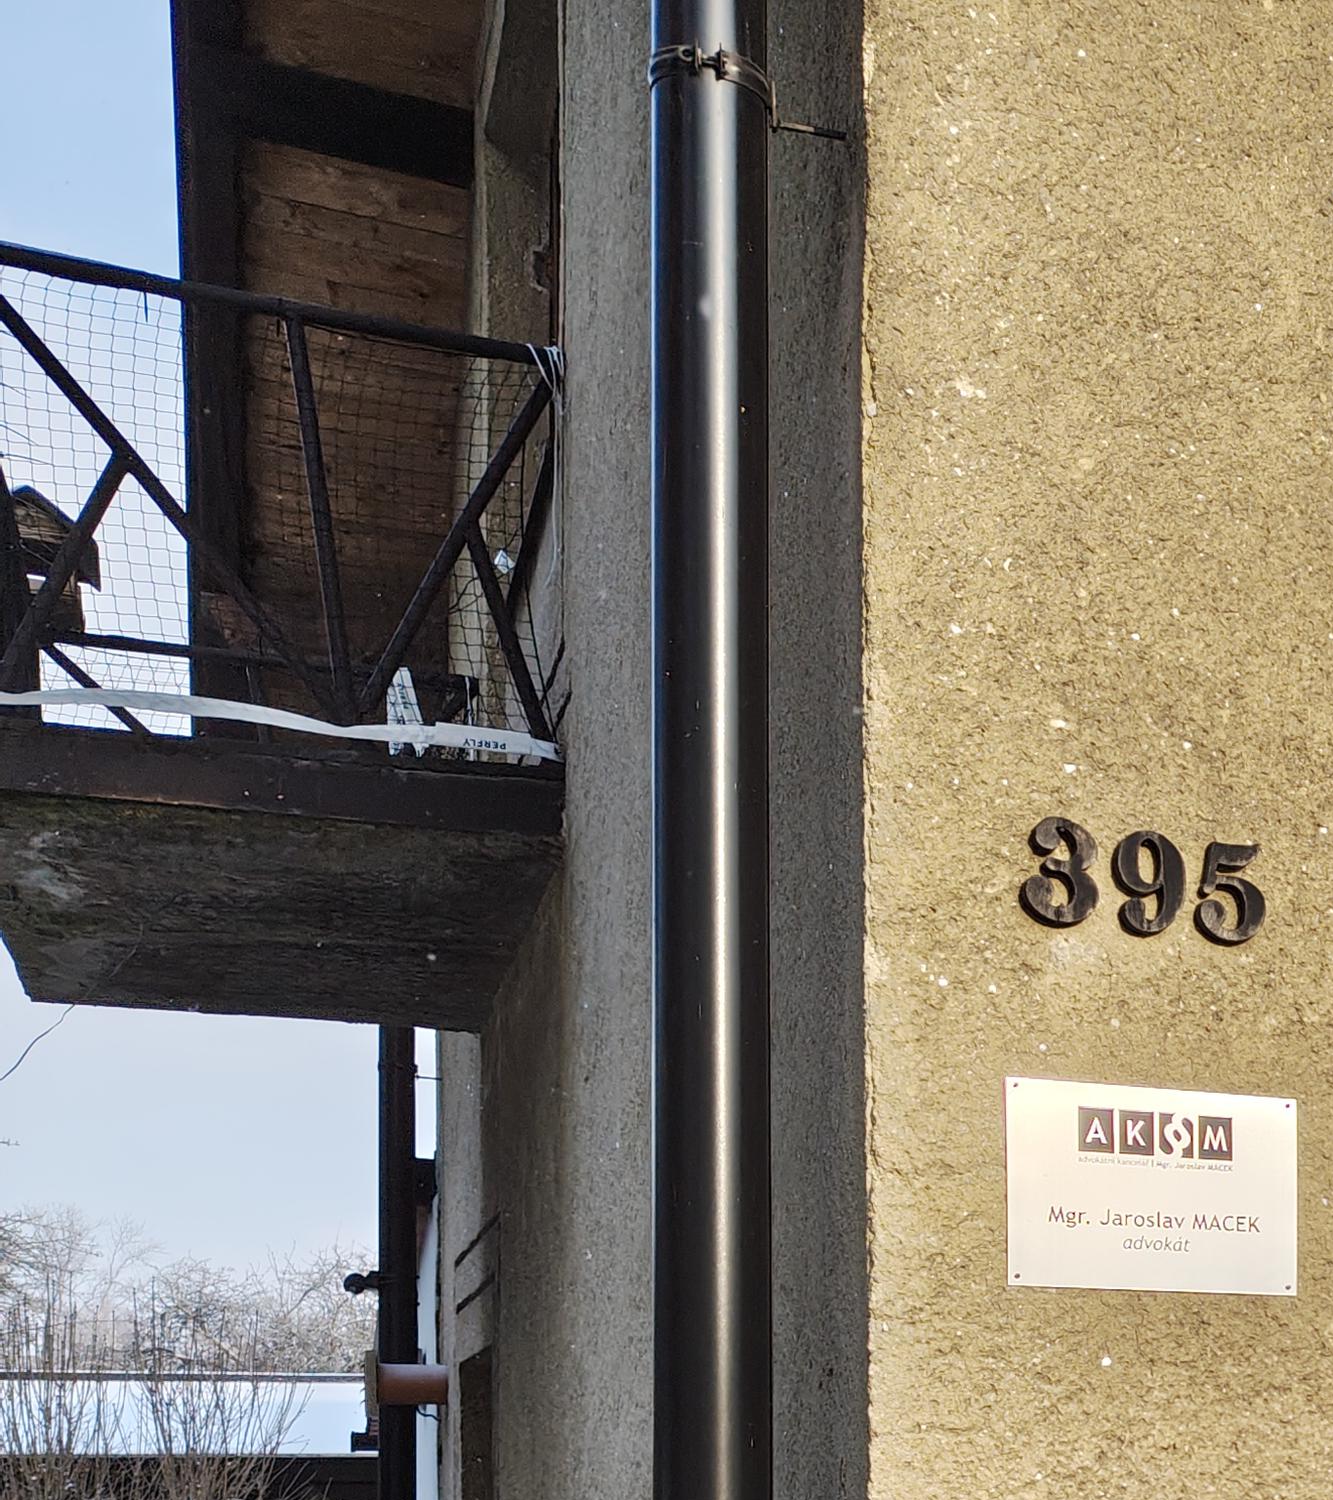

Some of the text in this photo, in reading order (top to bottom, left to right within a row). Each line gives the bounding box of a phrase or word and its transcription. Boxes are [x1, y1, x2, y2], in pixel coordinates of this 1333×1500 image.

[463, 738, 506, 750] PERFLY
[1018, 816, 1266, 946] 395
[1048, 1206, 1261, 1233] Mgr. Jaroslav MACEK
[1122, 1236, 1191, 1253] advokát
